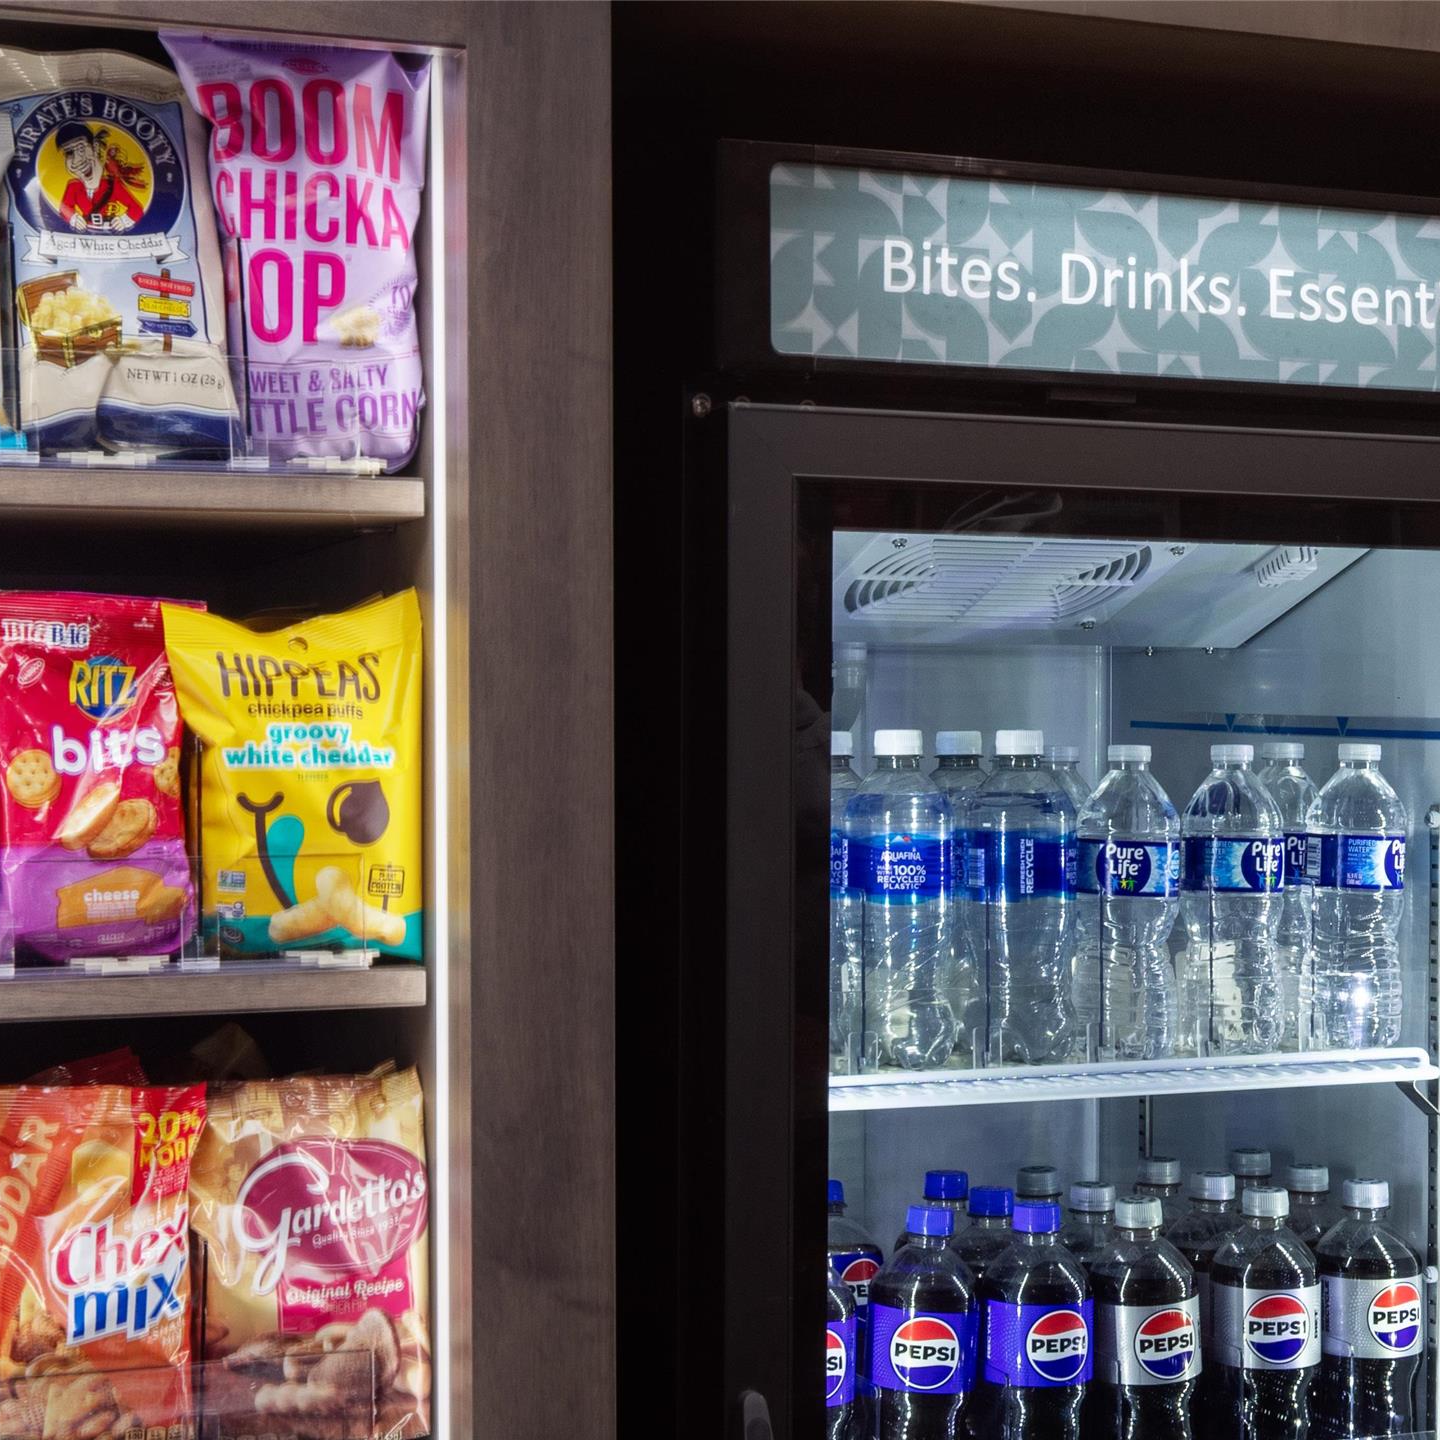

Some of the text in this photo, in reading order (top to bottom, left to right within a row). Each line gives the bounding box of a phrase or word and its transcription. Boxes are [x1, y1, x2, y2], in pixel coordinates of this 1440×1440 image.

[19, 91, 175, 166] PIRATE'S BOOTY
[197, 78, 404, 183] BOOM
[215, 169, 409, 251] CHICKA
[46, 235, 164, 253] Aged White Cheddar
[882, 237, 1037, 304] Bites.
[1060, 253, 1247, 318] Drinks.
[69, 660, 138, 708] RITZ
[216, 651, 381, 703] HIPPEAS
[248, 702, 364, 720] chickpea puffs
[269, 723, 351, 745] groovy
[51, 724, 167, 776] bits
[225, 743, 394, 768] white cheddar
[880, 850, 922, 862] AQUAFINA
[1105, 843, 1144, 862] Pure
[1251, 840, 1281, 858] Pure
[1348, 846, 1371, 854] WATER
[893, 864, 927, 877] 100%
[1026, 838, 1035, 895] RECYCLE
[1109, 858, 1142, 878] Life
[1255, 854, 1279, 872] Life
[877, 874, 926, 884] RECYCLED
[883, 882, 921, 891] PLASTIC
[84, 887, 140, 902] cheese
[234, 1155, 426, 1295] Gardetto's
[55, 1208, 189, 1287] Chex
[73, 1258, 185, 1340] mix
[286, 1281, 352, 1309] Original
[354, 1277, 405, 1299] Recipe
[1372, 1307, 1421, 1326] PEPSI
[1248, 1319, 1307, 1337] PEPSI
[894, 1341, 956, 1362] PEPSI
[1031, 1336, 1086, 1354] PEPSI
[1139, 1332, 1193, 1354] PEPSI
